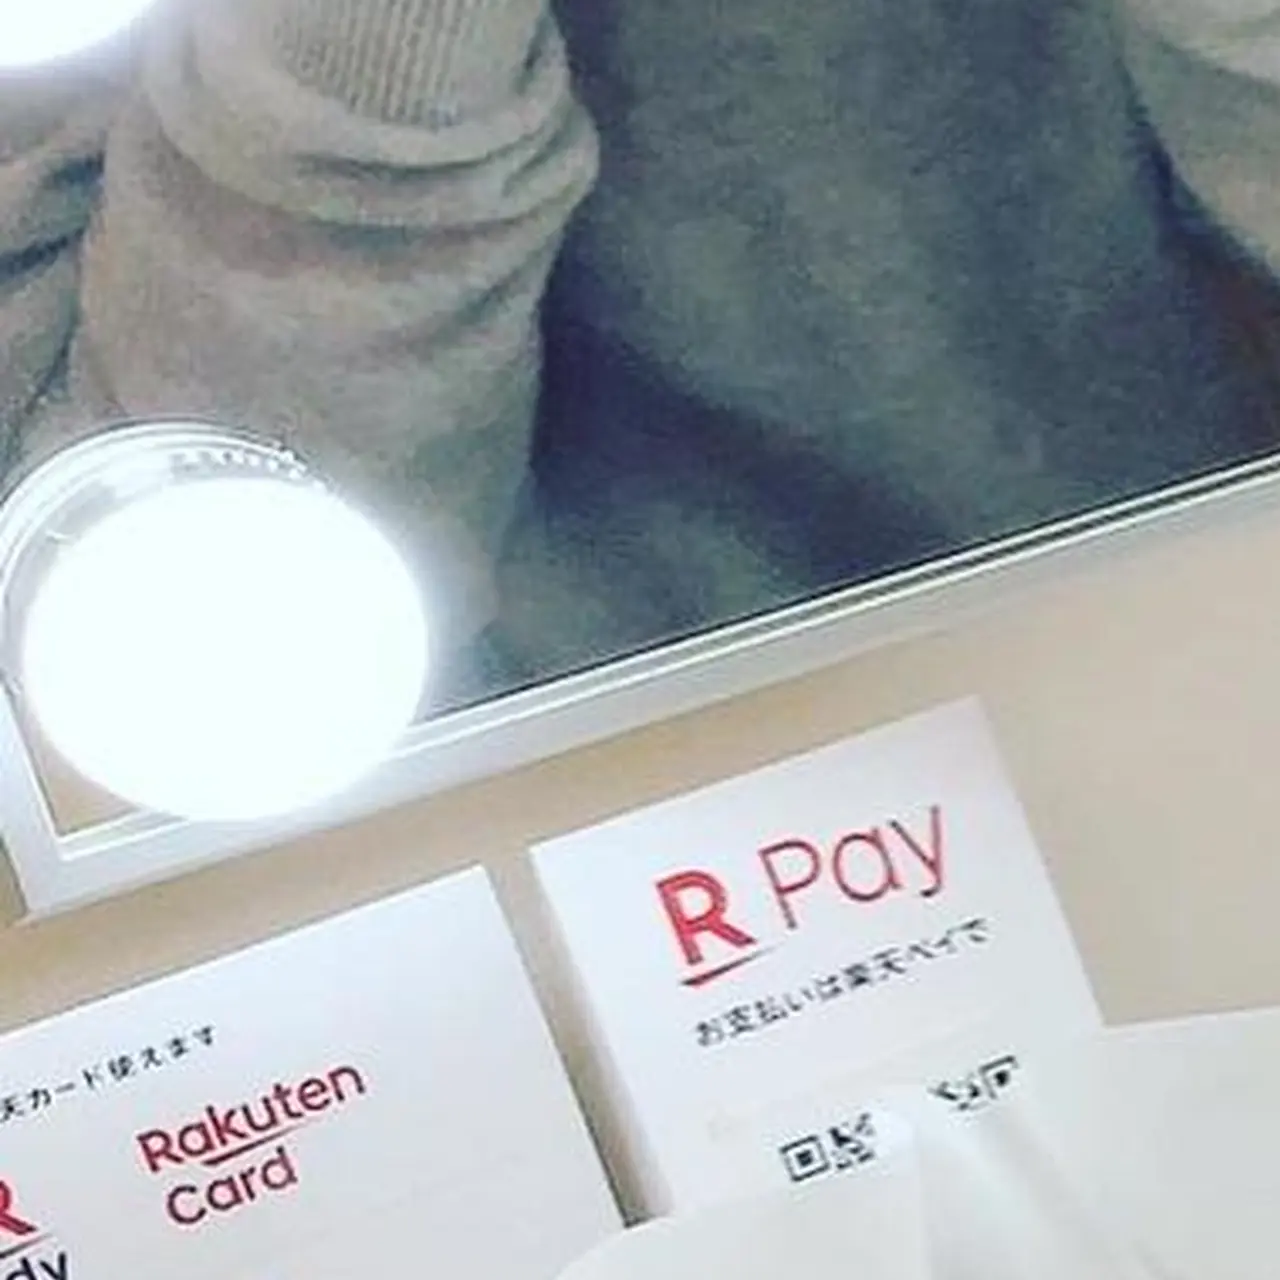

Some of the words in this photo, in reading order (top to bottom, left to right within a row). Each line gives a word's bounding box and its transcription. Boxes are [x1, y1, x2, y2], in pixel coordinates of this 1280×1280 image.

[758, 804, 946, 930] Pay
[693, 916, 997, 1050] お支払いは楽天ペイで
[134, 1063, 367, 1174] Rakuten
